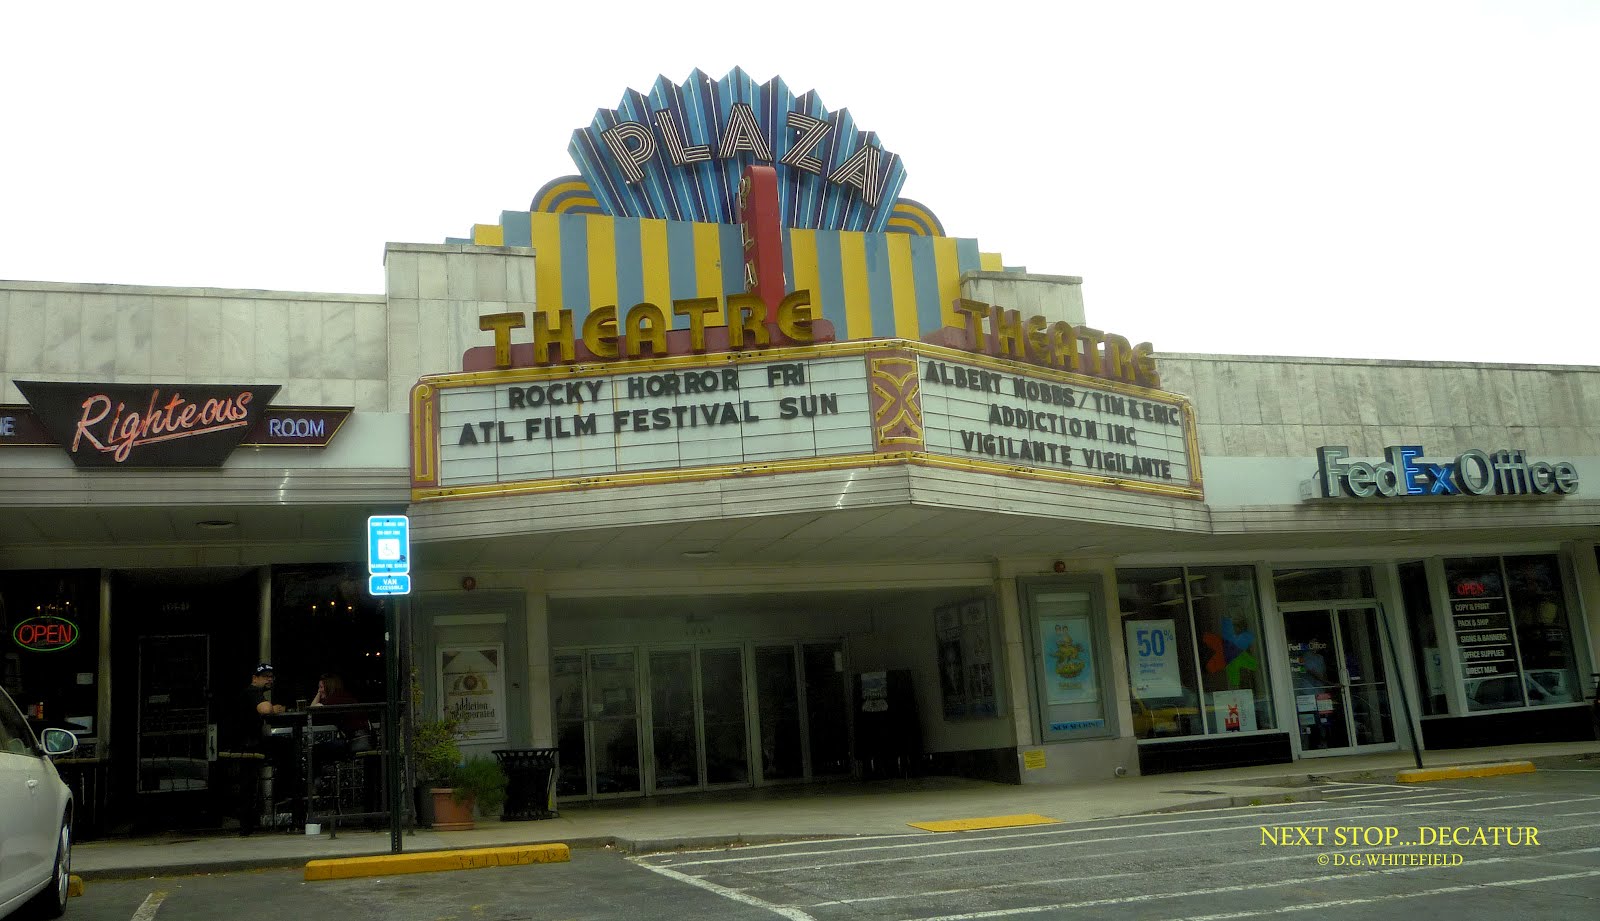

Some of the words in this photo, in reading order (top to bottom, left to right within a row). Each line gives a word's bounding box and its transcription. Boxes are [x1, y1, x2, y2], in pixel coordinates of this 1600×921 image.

[601, 102, 881, 210] PLAZA
[479, 290, 814, 368] THEATRE
[953, 298, 1158, 389] THEATRE
[508, 379, 603, 410] ROCKY
[628, 368, 739, 399] HORROR
[767, 362, 804, 388] FRI
[925, 360, 1002, 395] ALBERT
[72, 388, 253, 462] Righteous
[268, 418, 325, 438] ROOM
[458, 420, 514, 446] ATL
[525, 413, 597, 440] FILM
[614, 400, 759, 433] FESTIVAL
[780, 393, 838, 420] SUN
[989, 403, 1097, 440] ADDICTION
[1107, 423, 1137, 446] INC
[960, 429, 1073, 466] VIGILANTE
[1082, 447, 1172, 480] VIGILANTE
[1317, 445, 1456, 498] FedEx
[1454, 449, 1579, 495] Office
[1455, 603, 1469, 611] COPY
[1475, 602, 1490, 610] PRINT
[1457, 582, 1485, 596] OPEN
[18, 623, 72, 644] OPEN
[1457, 619, 1471, 627] PACK
[1477, 618, 1489, 626] SHIP
[1460, 635, 1477, 643] SIGNS
[1482, 633, 1507, 641] BANNERS
[1463, 650, 1480, 659] OFFICE
[1481, 649, 1505, 657] SUPPLIES
[1465, 667, 1484, 675] DIRECT
